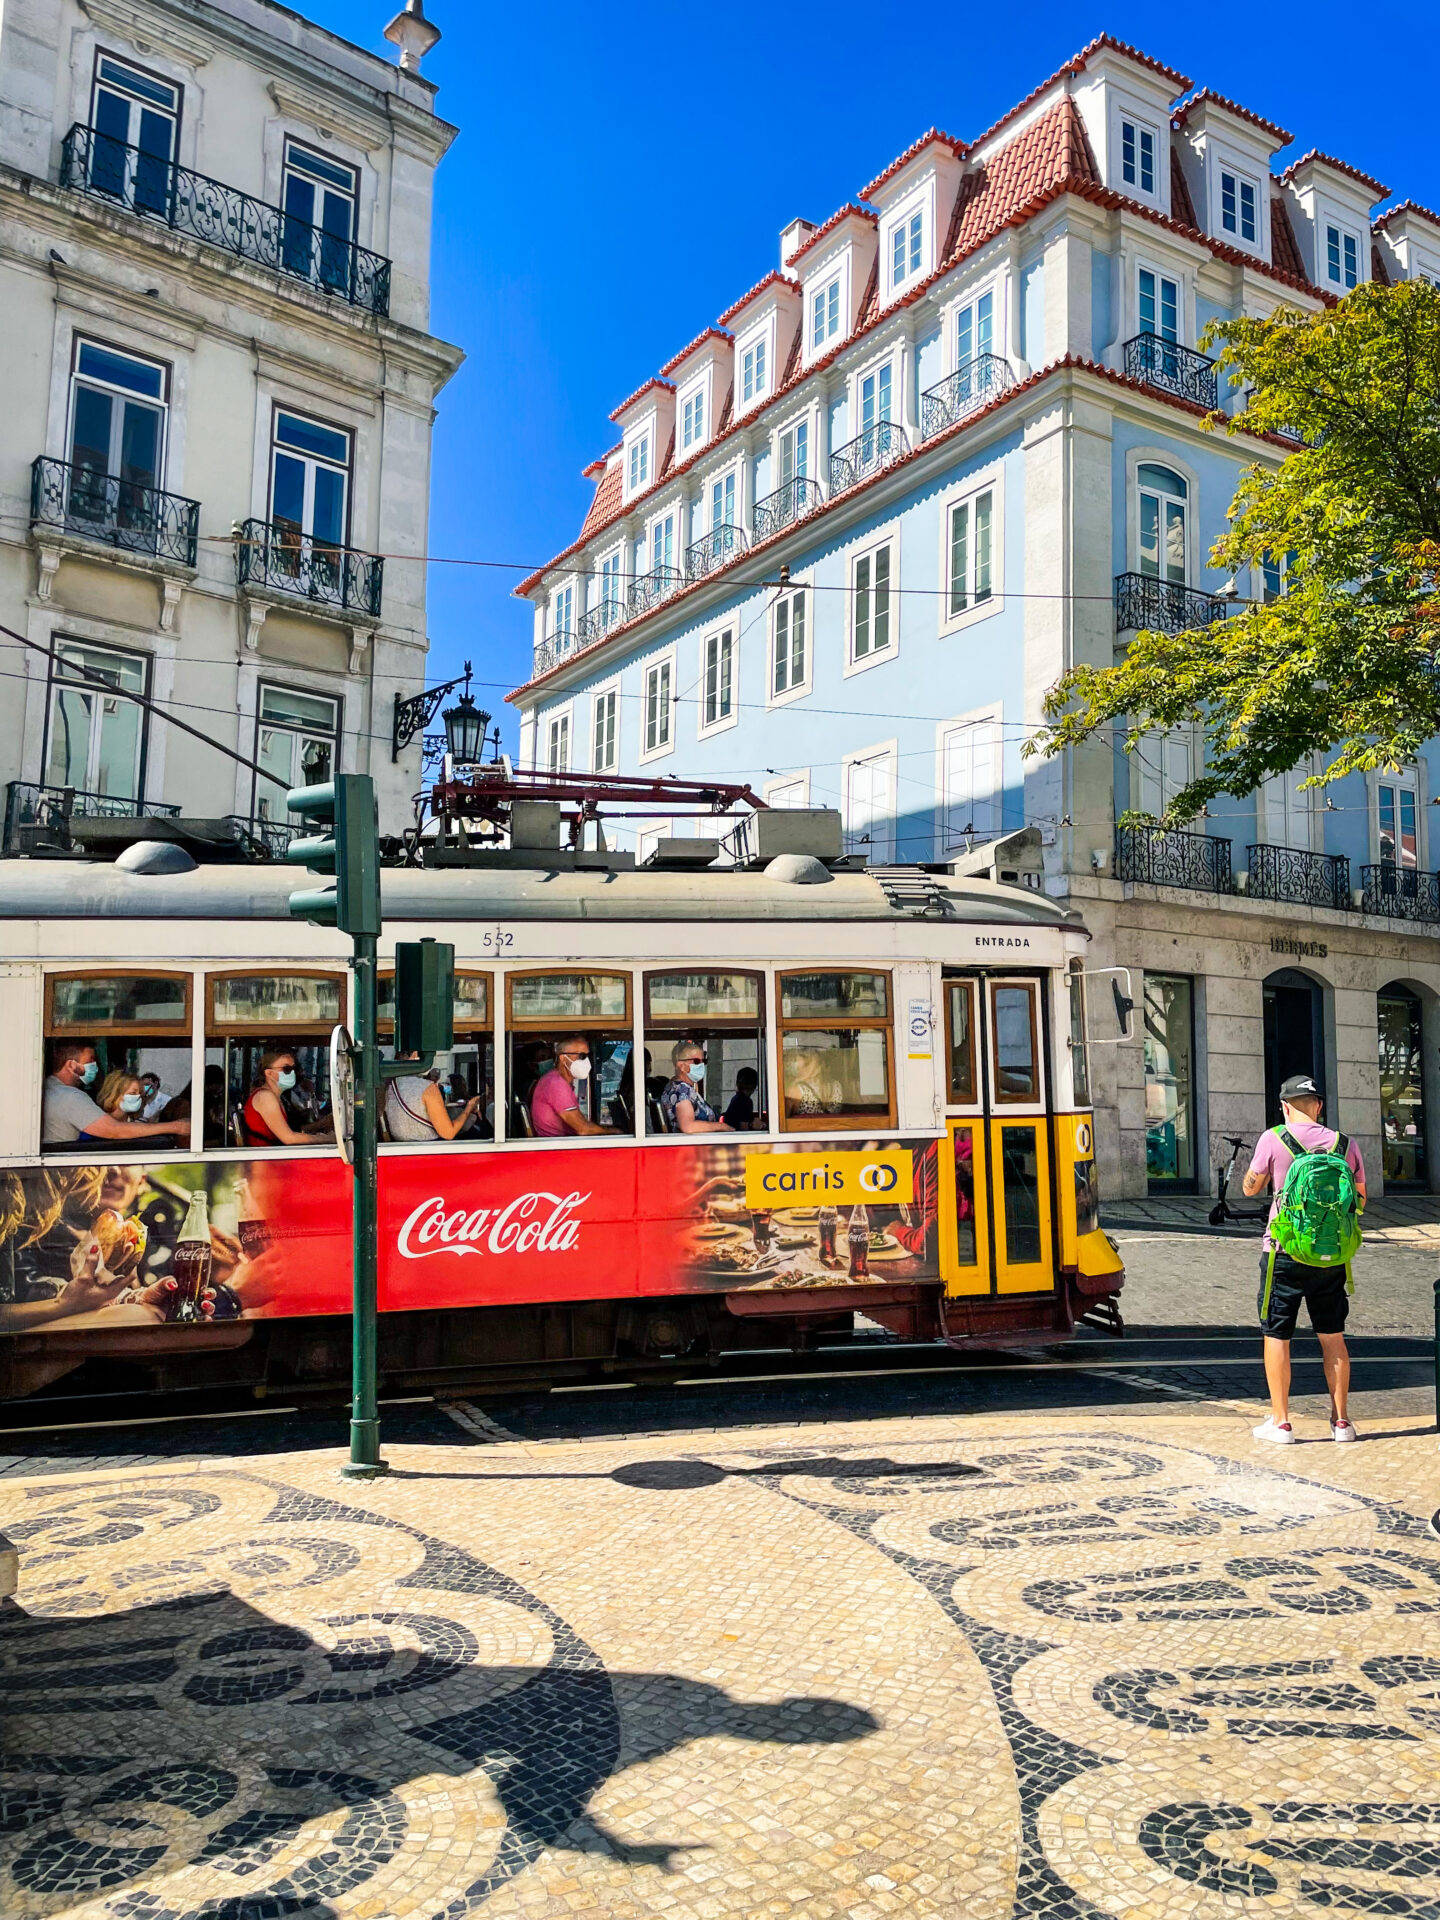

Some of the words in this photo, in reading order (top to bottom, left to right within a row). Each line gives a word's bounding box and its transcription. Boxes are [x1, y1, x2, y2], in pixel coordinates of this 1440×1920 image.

[483, 932, 514, 946] 552
[975, 937, 1030, 947] ENTRADA
[762, 1163, 844, 1191] carris
[397, 1191, 592, 1258] Coca-Cola
